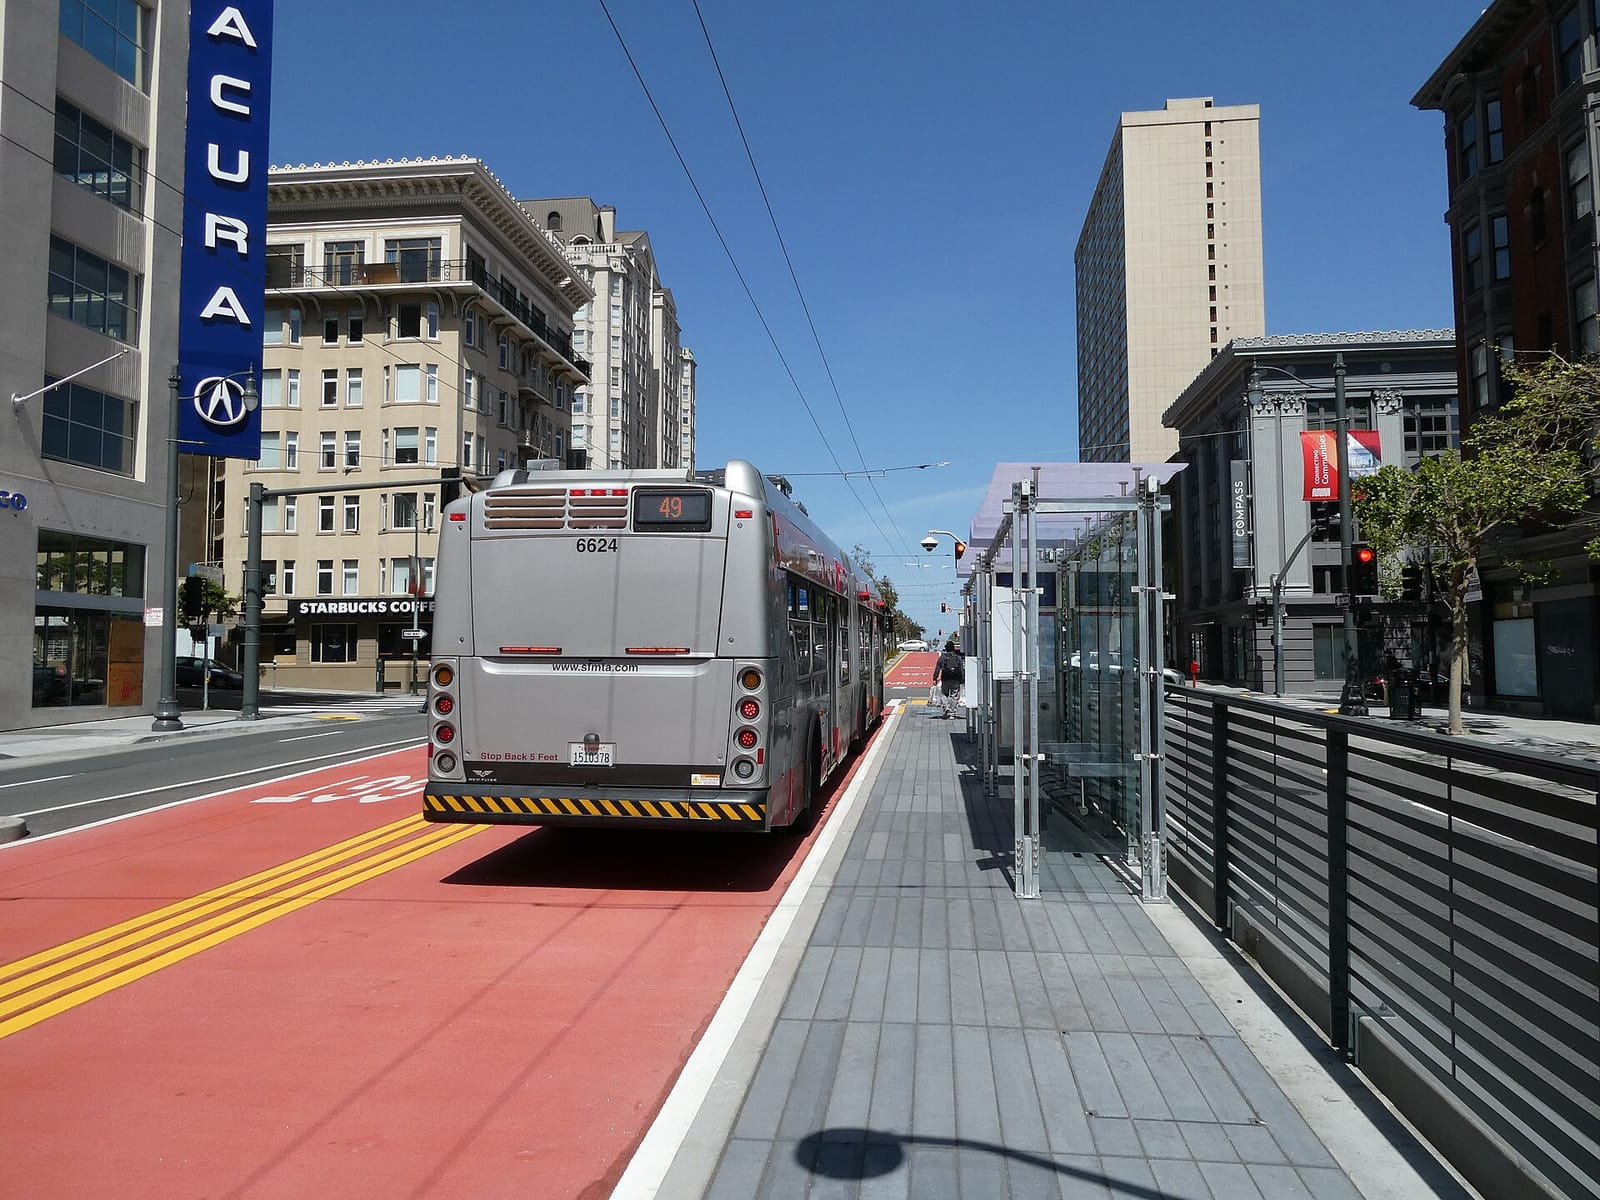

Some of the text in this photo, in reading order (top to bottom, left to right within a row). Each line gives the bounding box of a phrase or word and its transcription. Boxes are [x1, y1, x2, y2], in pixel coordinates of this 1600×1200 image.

[200, 6, 258, 325] ACURA
[1319, 434, 1329, 485] Communities
[659, 496, 683, 518] 49
[1234, 480, 1245, 537] COMPASS
[576, 538, 618, 553] 6624
[300, 601, 387, 614] STARBUCKS
[552, 662, 639, 672] www.sfmta.com
[480, 752, 501, 761] Stop
[504, 753, 527, 761] Back
[538, 753, 558, 761] Feet
[573, 752, 610, 763] 1510378
